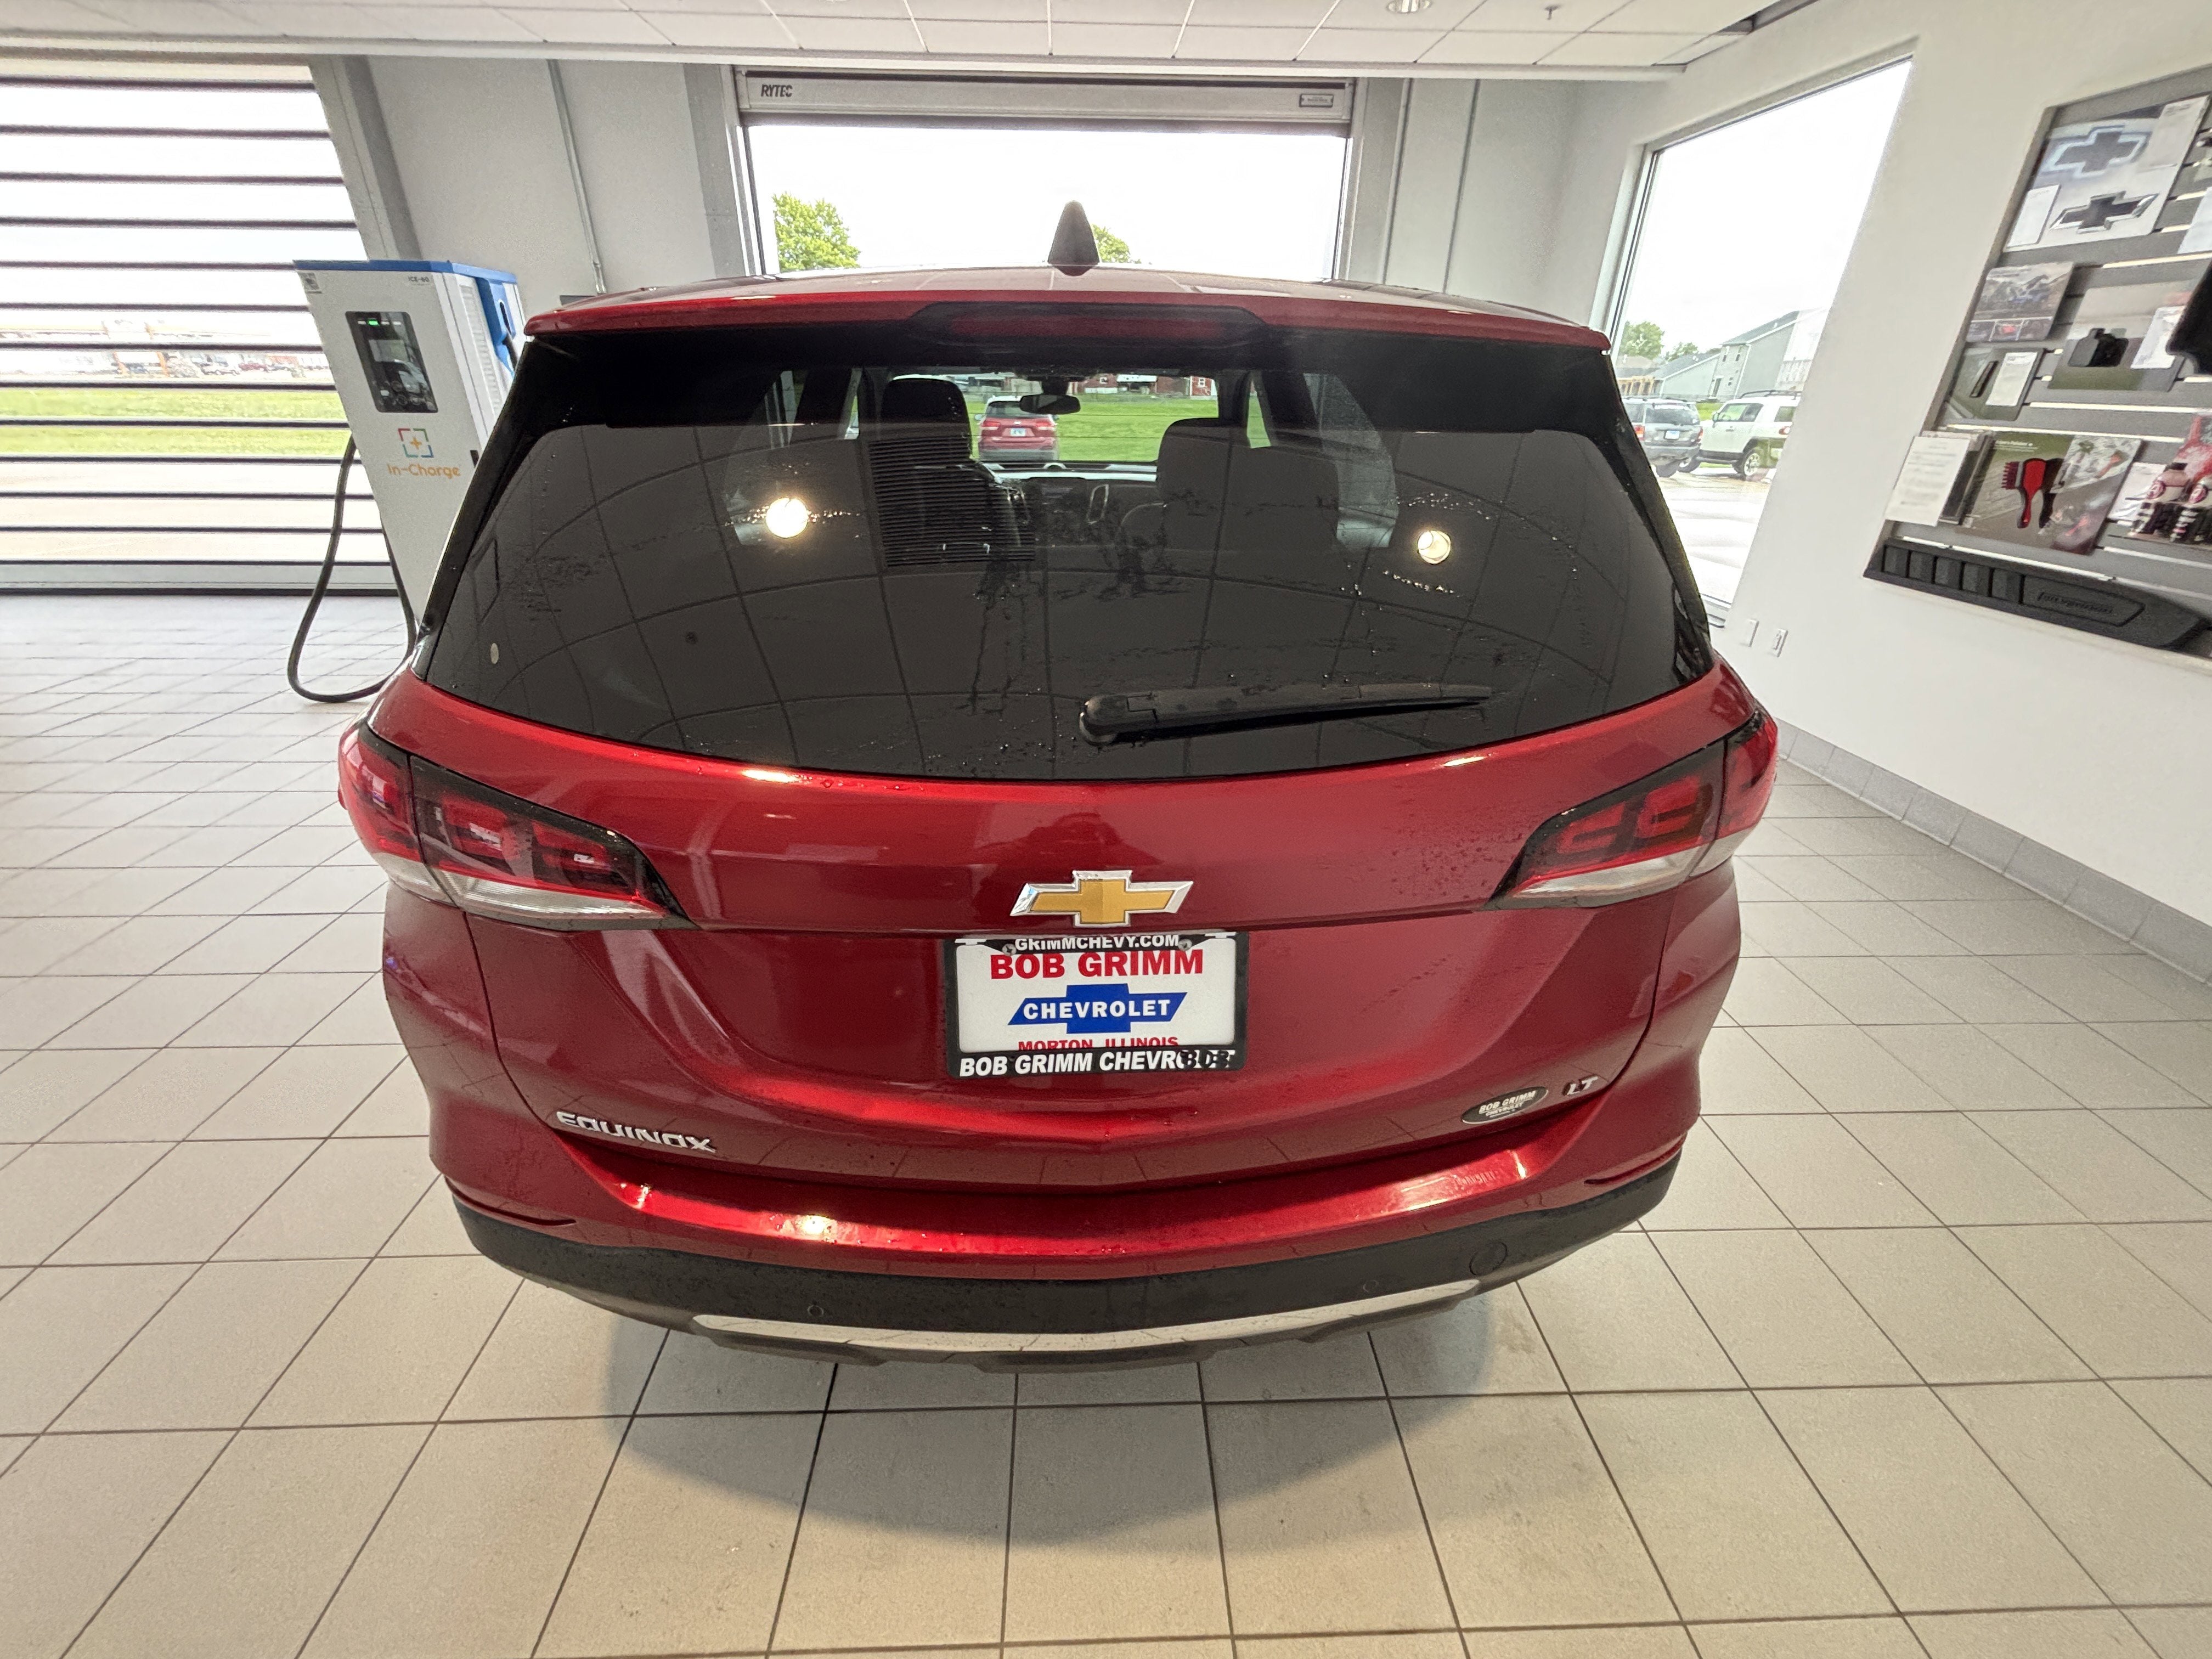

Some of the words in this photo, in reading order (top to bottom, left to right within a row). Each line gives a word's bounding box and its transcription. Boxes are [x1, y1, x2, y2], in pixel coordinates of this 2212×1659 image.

[761, 84, 793, 97] RYTEC
[386, 462, 461, 479] In-Charge
[1014, 934, 1180, 951] GRIMMCHEVY.COM
[990, 953, 1065, 979] BOB
[1078, 949, 1203, 977] GRIMM
[1023, 999, 1170, 1020] CHEVROLET
[960, 1056, 1008, 1077] BOB
[1015, 1052, 1093, 1074] GRIMM
[1567, 1075, 1598, 1096] LT
[1478, 1099, 1500, 1113] BOB
[1502, 1090, 1536, 1105] GRIMM
[556, 1110, 716, 1153] EQUINOX
